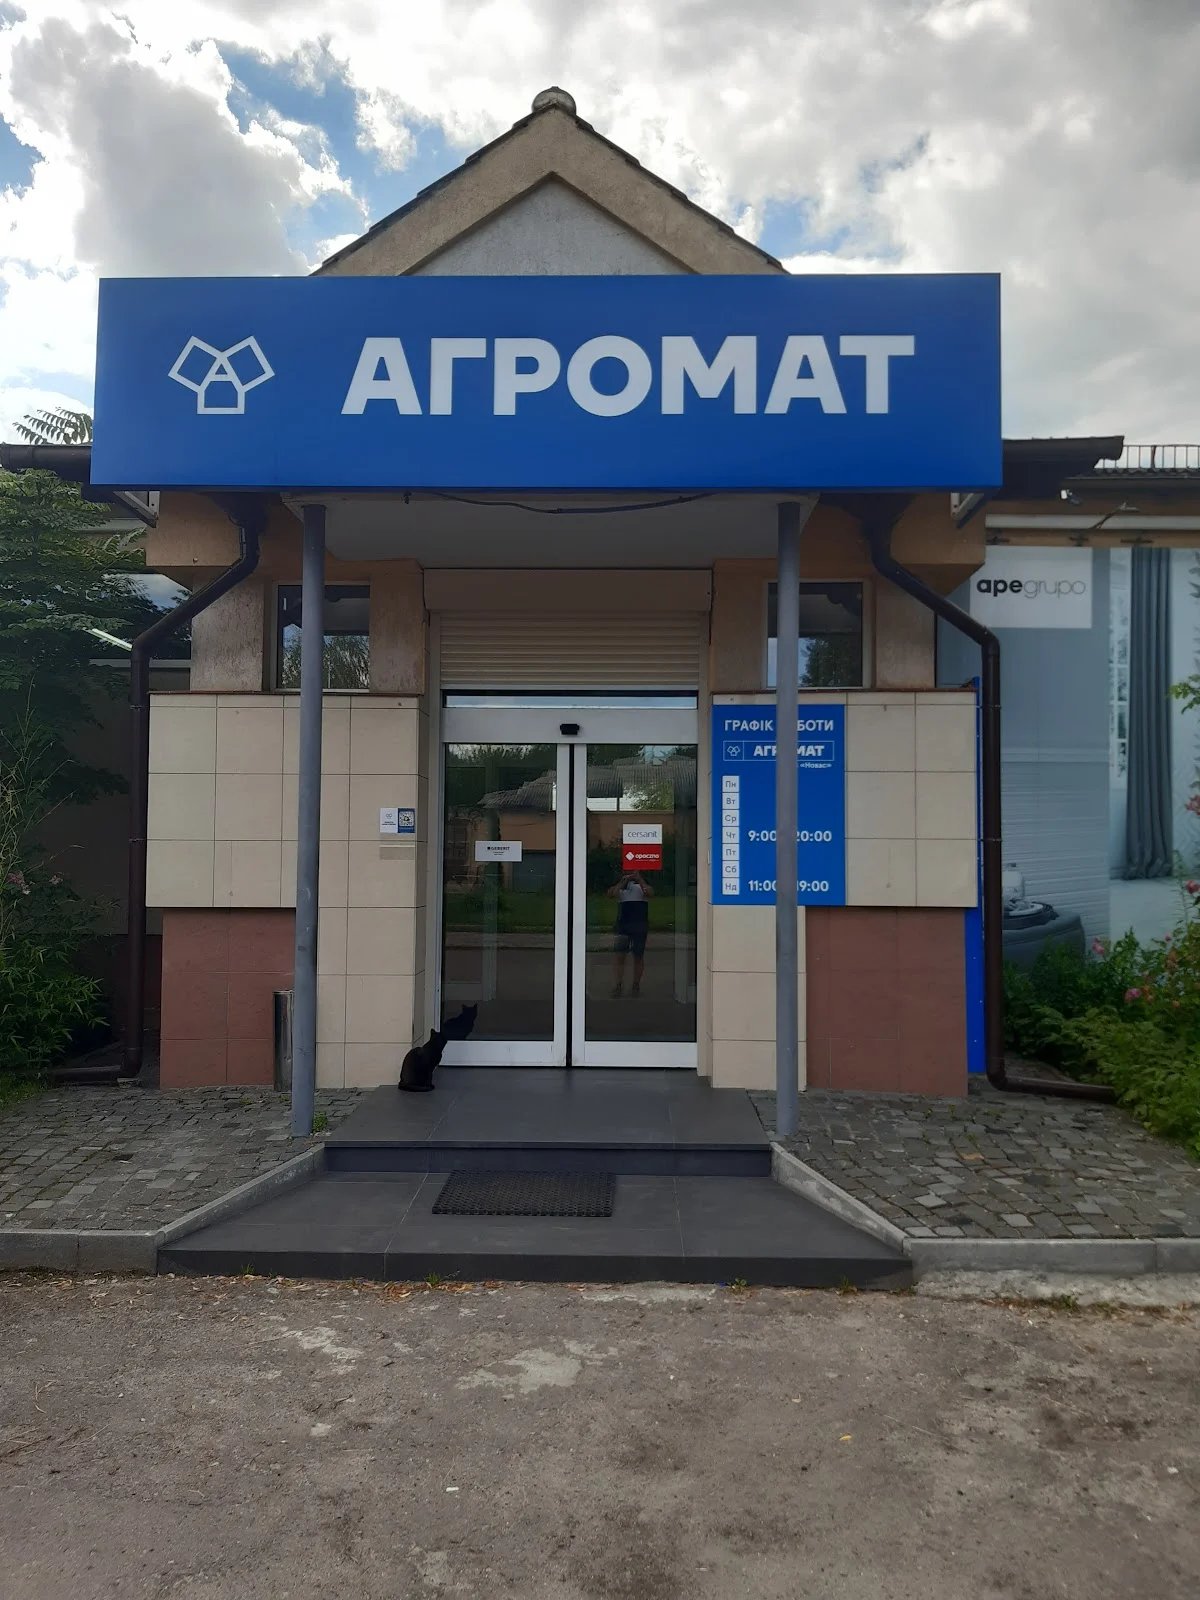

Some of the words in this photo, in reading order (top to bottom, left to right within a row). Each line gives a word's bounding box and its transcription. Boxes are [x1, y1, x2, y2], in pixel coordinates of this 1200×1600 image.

[341, 335, 915, 417] АГРОМАТ
[976, 578, 1087, 599] apegrupo
[724, 719, 774, 732] ГРАФІК
[797, 719, 834, 732] БОТИ
[753, 745, 825, 757] АГРМАТ
[725, 780, 737, 788] Пн
[726, 797, 736, 805] Вт
[725, 814, 737, 824] Ср
[627, 829, 658, 838] cersanit
[726, 831, 736, 839] Чт
[748, 829, 777, 842] 9:00
[726, 848, 736, 856] Пт
[725, 865, 737, 873] Сб
[725, 883, 737, 892] Нд
[748, 879, 777, 892] 11:00
